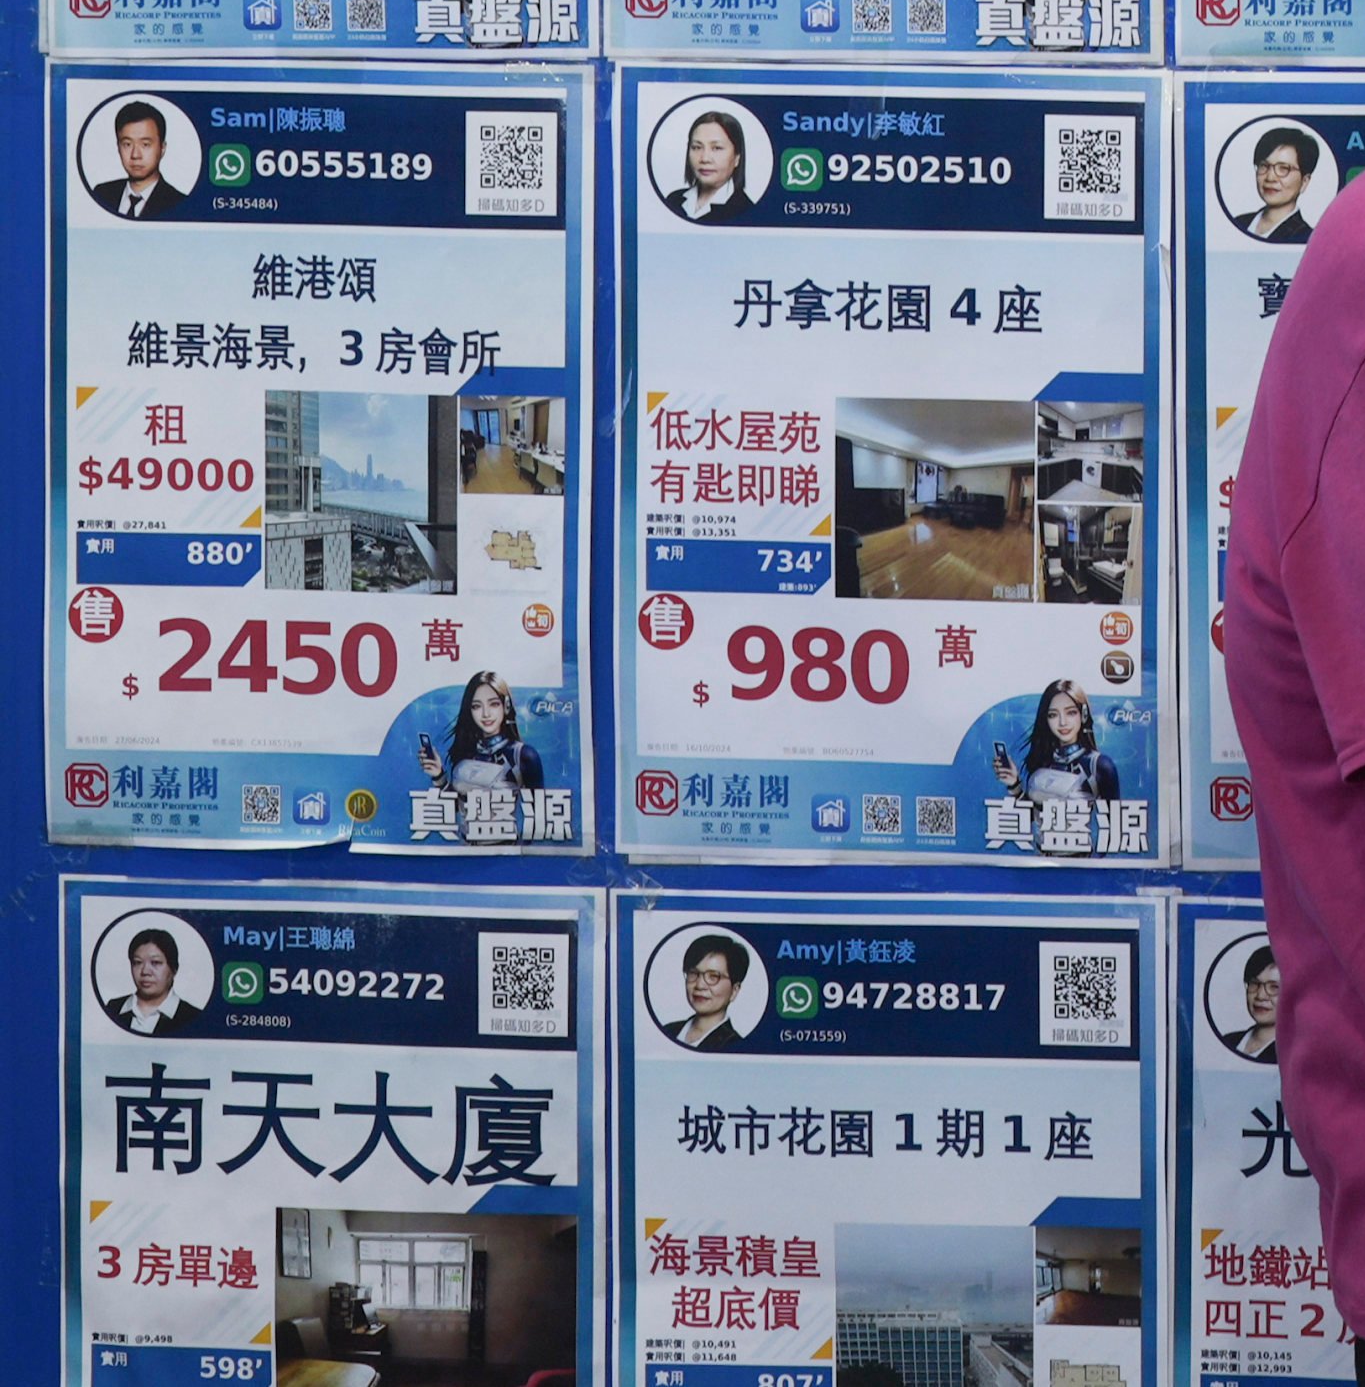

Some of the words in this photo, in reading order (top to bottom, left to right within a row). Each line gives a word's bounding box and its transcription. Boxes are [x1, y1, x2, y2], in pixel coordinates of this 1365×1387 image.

[256, 150, 432, 180] 60555189
[828, 154, 1011, 184] 92502510
[213, 197, 278, 211] (S-345484)
[784, 202, 850, 216] (S-339751)
[252, 253, 376, 303] 維港頌
[144, 404, 187, 446] 租
[649, 407, 820, 454] 低水屋苑
[79, 456, 254, 494] $49000
[651, 460, 820, 508] 有匙即睇
[73, 588, 116, 637] 售
[642, 596, 686, 644] 售
[422, 618, 463, 662] 萬
[935, 624, 977, 668] 萬
[113, 765, 218, 800] 利嘉閣
[683, 773, 789, 809] 利嘉閣
[408, 788, 572, 843] 真盤源
[983, 798, 1148, 853] 真盤源
[269, 968, 444, 1000] 54092272
[823, 982, 1005, 1010] 94728817
[226, 1014, 291, 1028] (S-284808)
[780, 1030, 846, 1043] (S-071559)
[105, 1062, 558, 1188] 南天大廈
[678, 1105, 873, 1157] 城市花園
[648, 1232, 820, 1277] 海景積皇
[672, 1285, 800, 1331] 超底價
